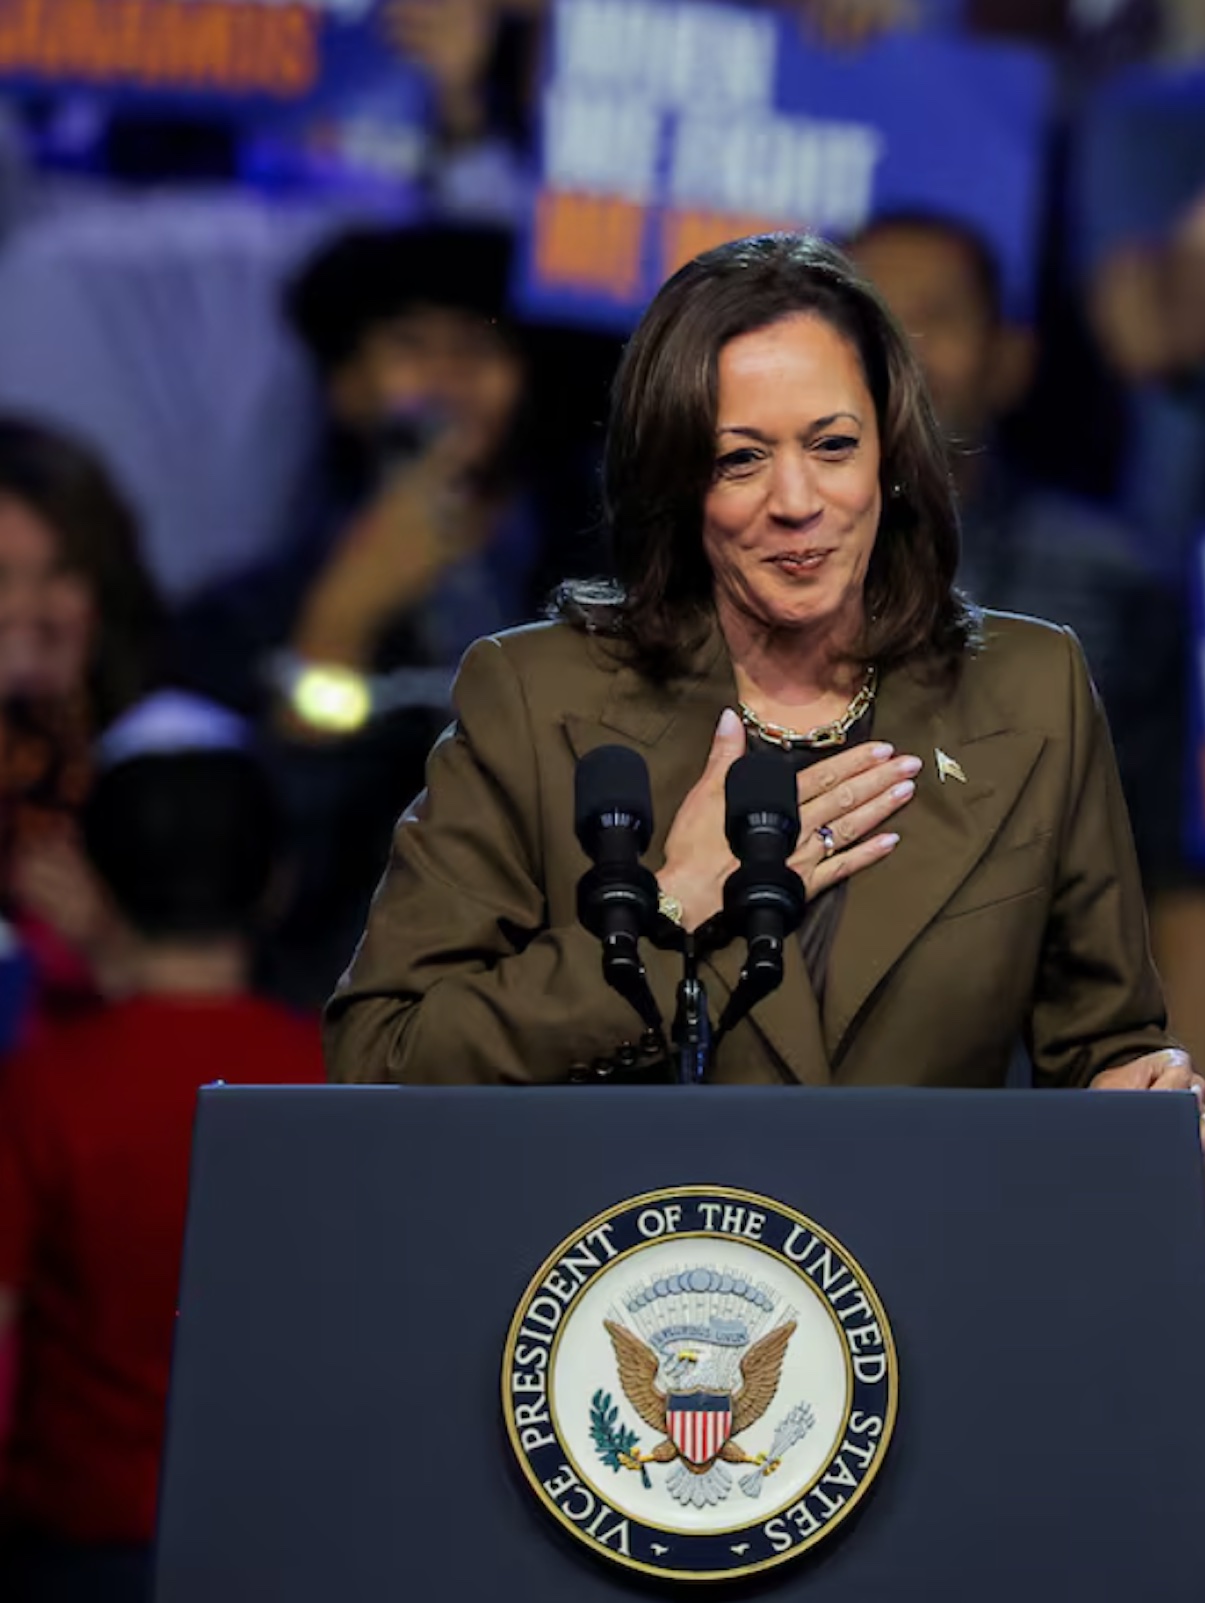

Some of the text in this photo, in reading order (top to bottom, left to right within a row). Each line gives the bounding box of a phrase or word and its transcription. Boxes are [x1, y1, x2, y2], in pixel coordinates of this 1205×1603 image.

[512, 1203, 886, 1556] VICE PRESIDENT OF THE UNITED STATES
